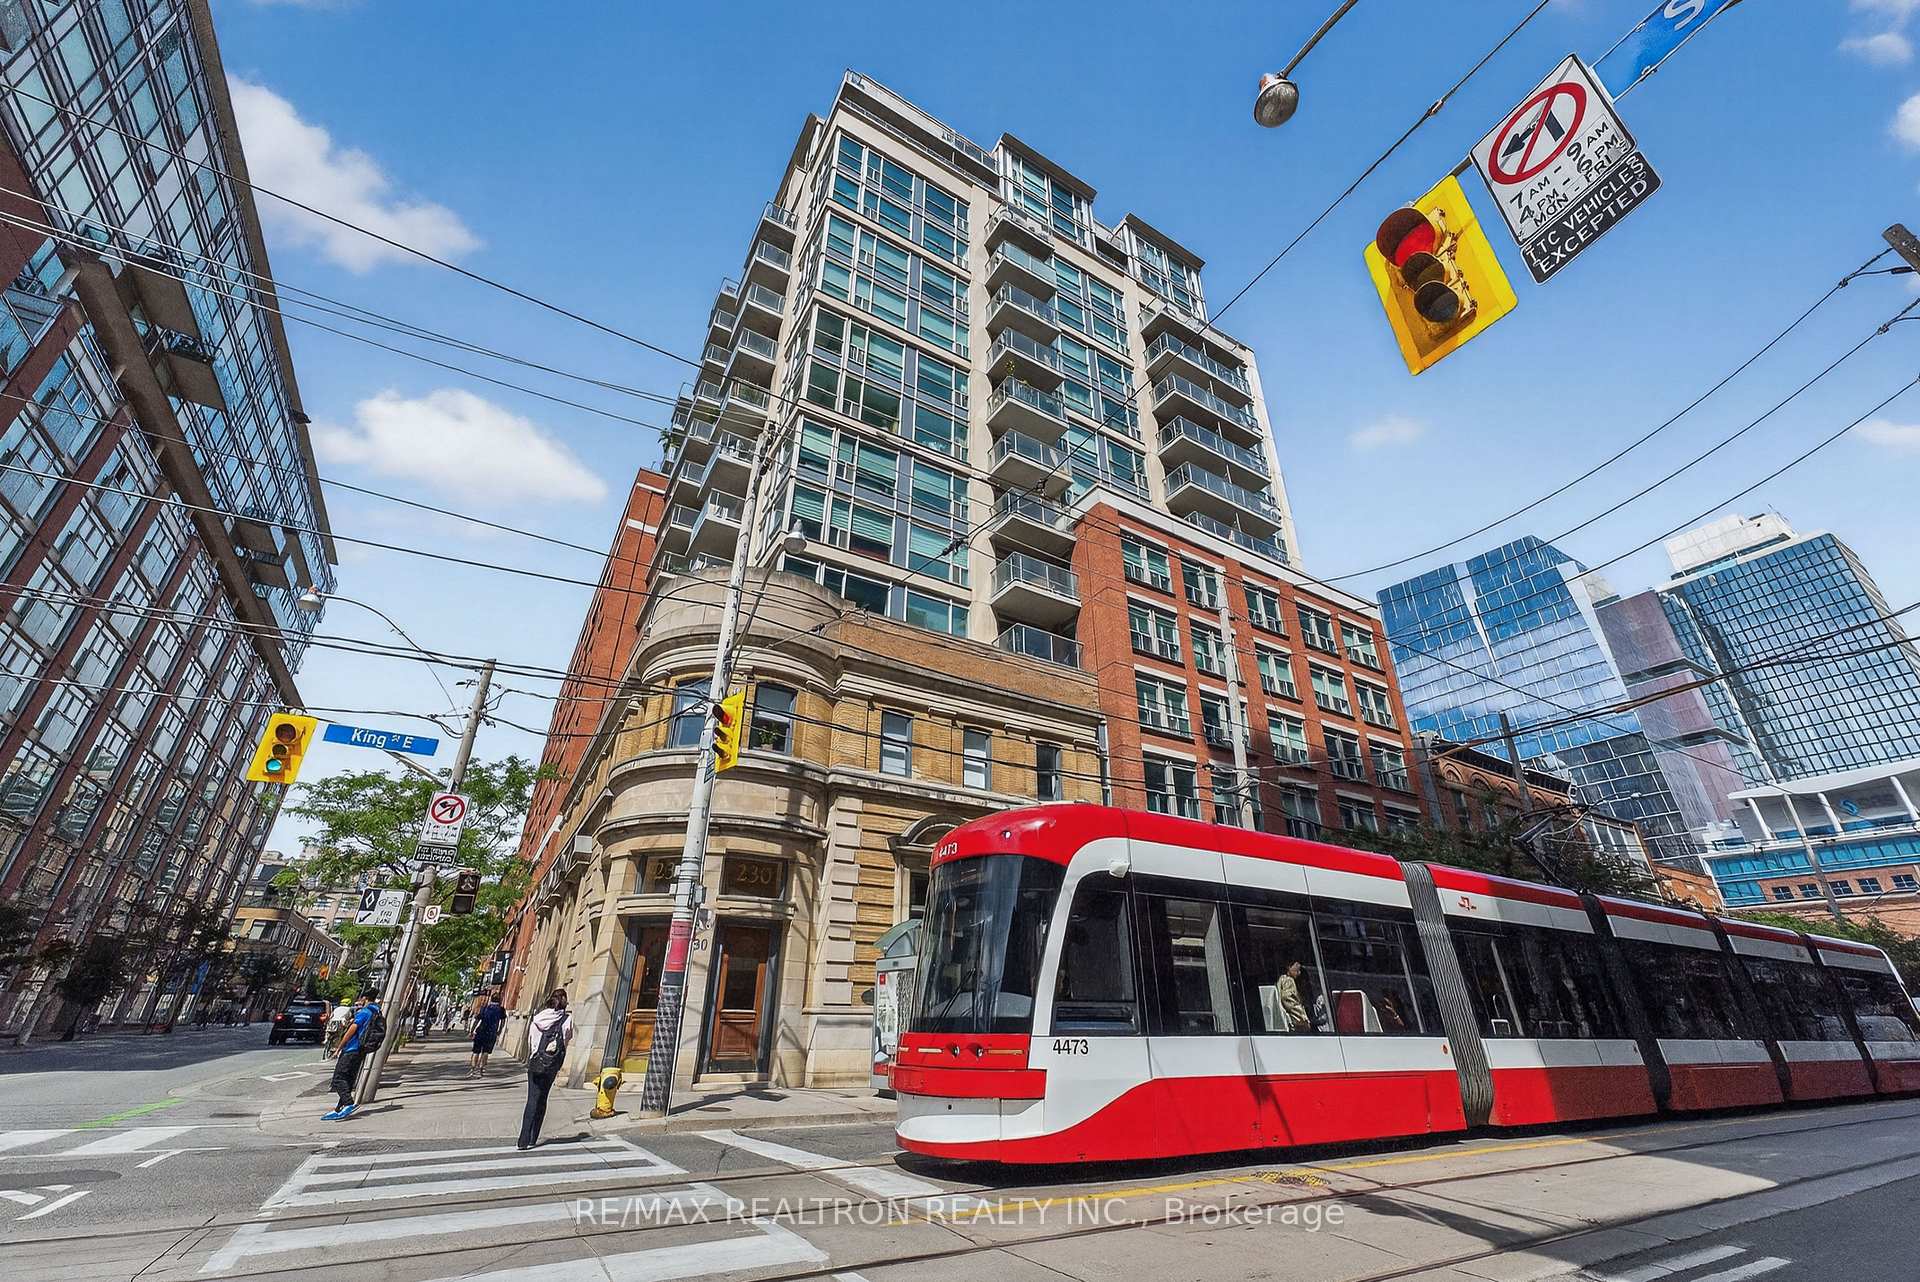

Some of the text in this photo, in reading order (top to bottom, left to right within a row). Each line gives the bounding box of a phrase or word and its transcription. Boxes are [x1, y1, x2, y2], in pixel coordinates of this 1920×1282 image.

[1510, 190, 1523, 209] 7
[1529, 176, 1551, 200] AM
[1566, 141, 1582, 162] 9
[1586, 122, 1609, 148] AM
[1519, 205, 1535, 224] 4
[1536, 188, 1560, 211] PM
[1576, 153, 1593, 174] 6
[1594, 134, 1619, 160] PM
[1525, 155, 1645, 265] TTC VEHICLES
[1533, 192, 1569, 228] MON
[1583, 155, 1612, 183] FRI
[1539, 179, 1648, 274] EXCEPTED
[351, 728, 387, 748] King
[402, 736, 414, 749] E
[654, 862, 676, 880] 23
[736, 863, 772, 884] 230
[692, 938, 708, 951] 30
[1052, 1039, 1089, 1055] 4473
